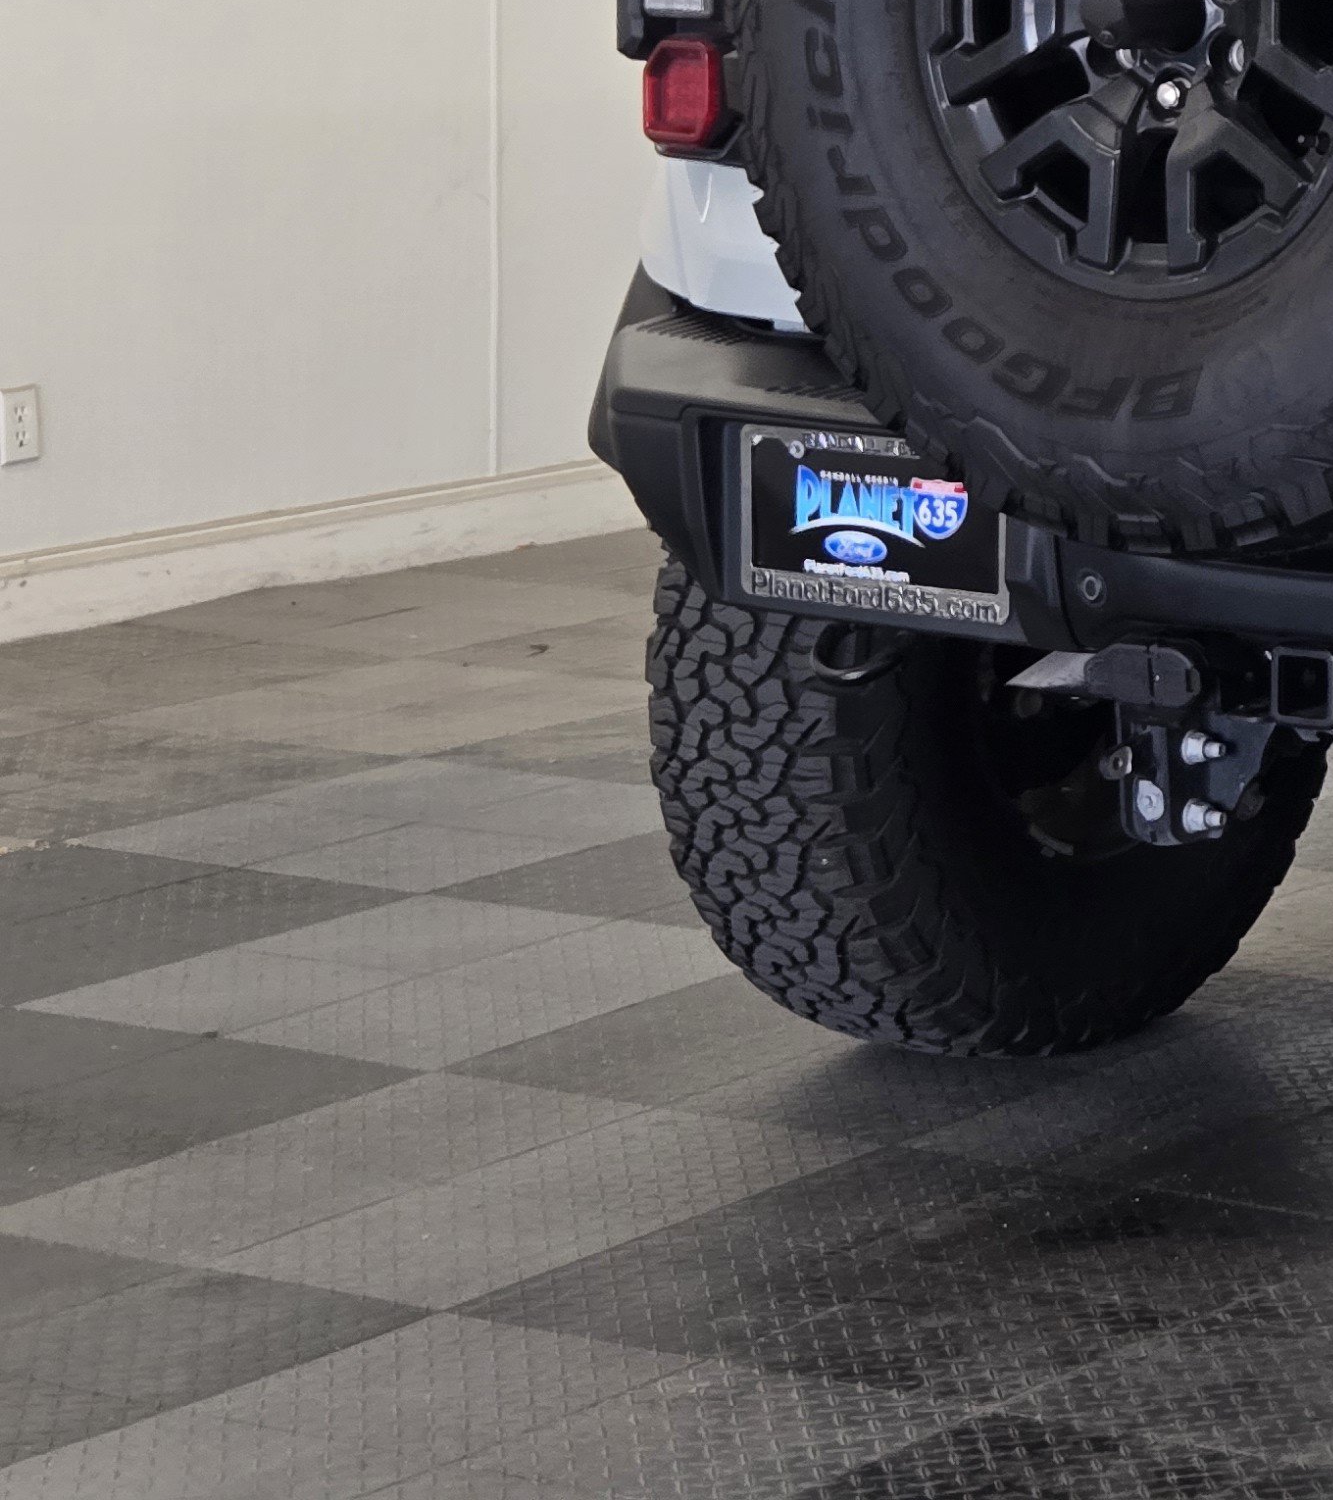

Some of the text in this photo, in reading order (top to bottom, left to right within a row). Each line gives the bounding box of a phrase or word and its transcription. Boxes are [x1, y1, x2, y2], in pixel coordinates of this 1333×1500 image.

[796, 463, 917, 540] PLANET
[917, 500, 959, 529] 635
[751, 571, 1001, 623] PlanetFord635.com
